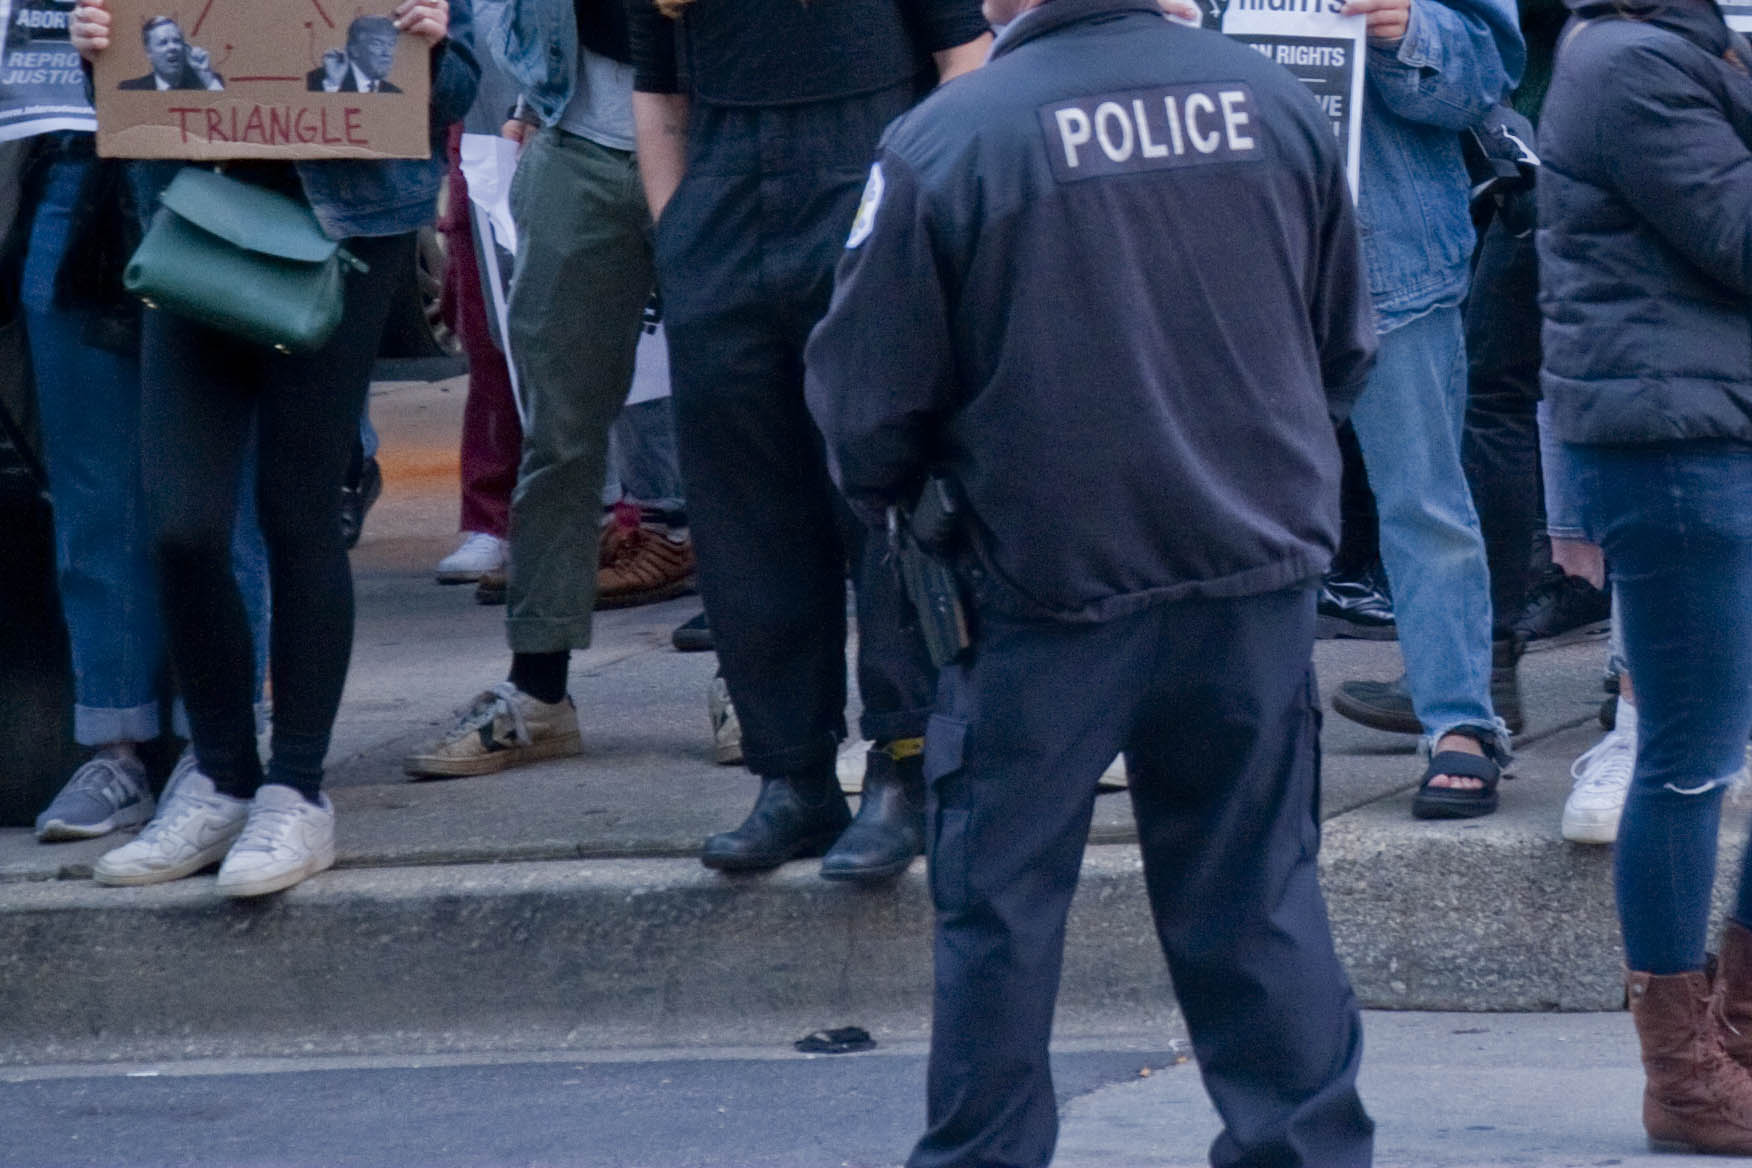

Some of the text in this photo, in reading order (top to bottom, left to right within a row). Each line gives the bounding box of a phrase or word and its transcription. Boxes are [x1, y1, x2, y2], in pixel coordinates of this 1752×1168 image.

[1276, 44, 1345, 67] RIGHTS
[2, 68, 84, 85] JUSTIC
[168, 105, 369, 145] TRIANGLE
[1055, 91, 1255, 168] POLICE
